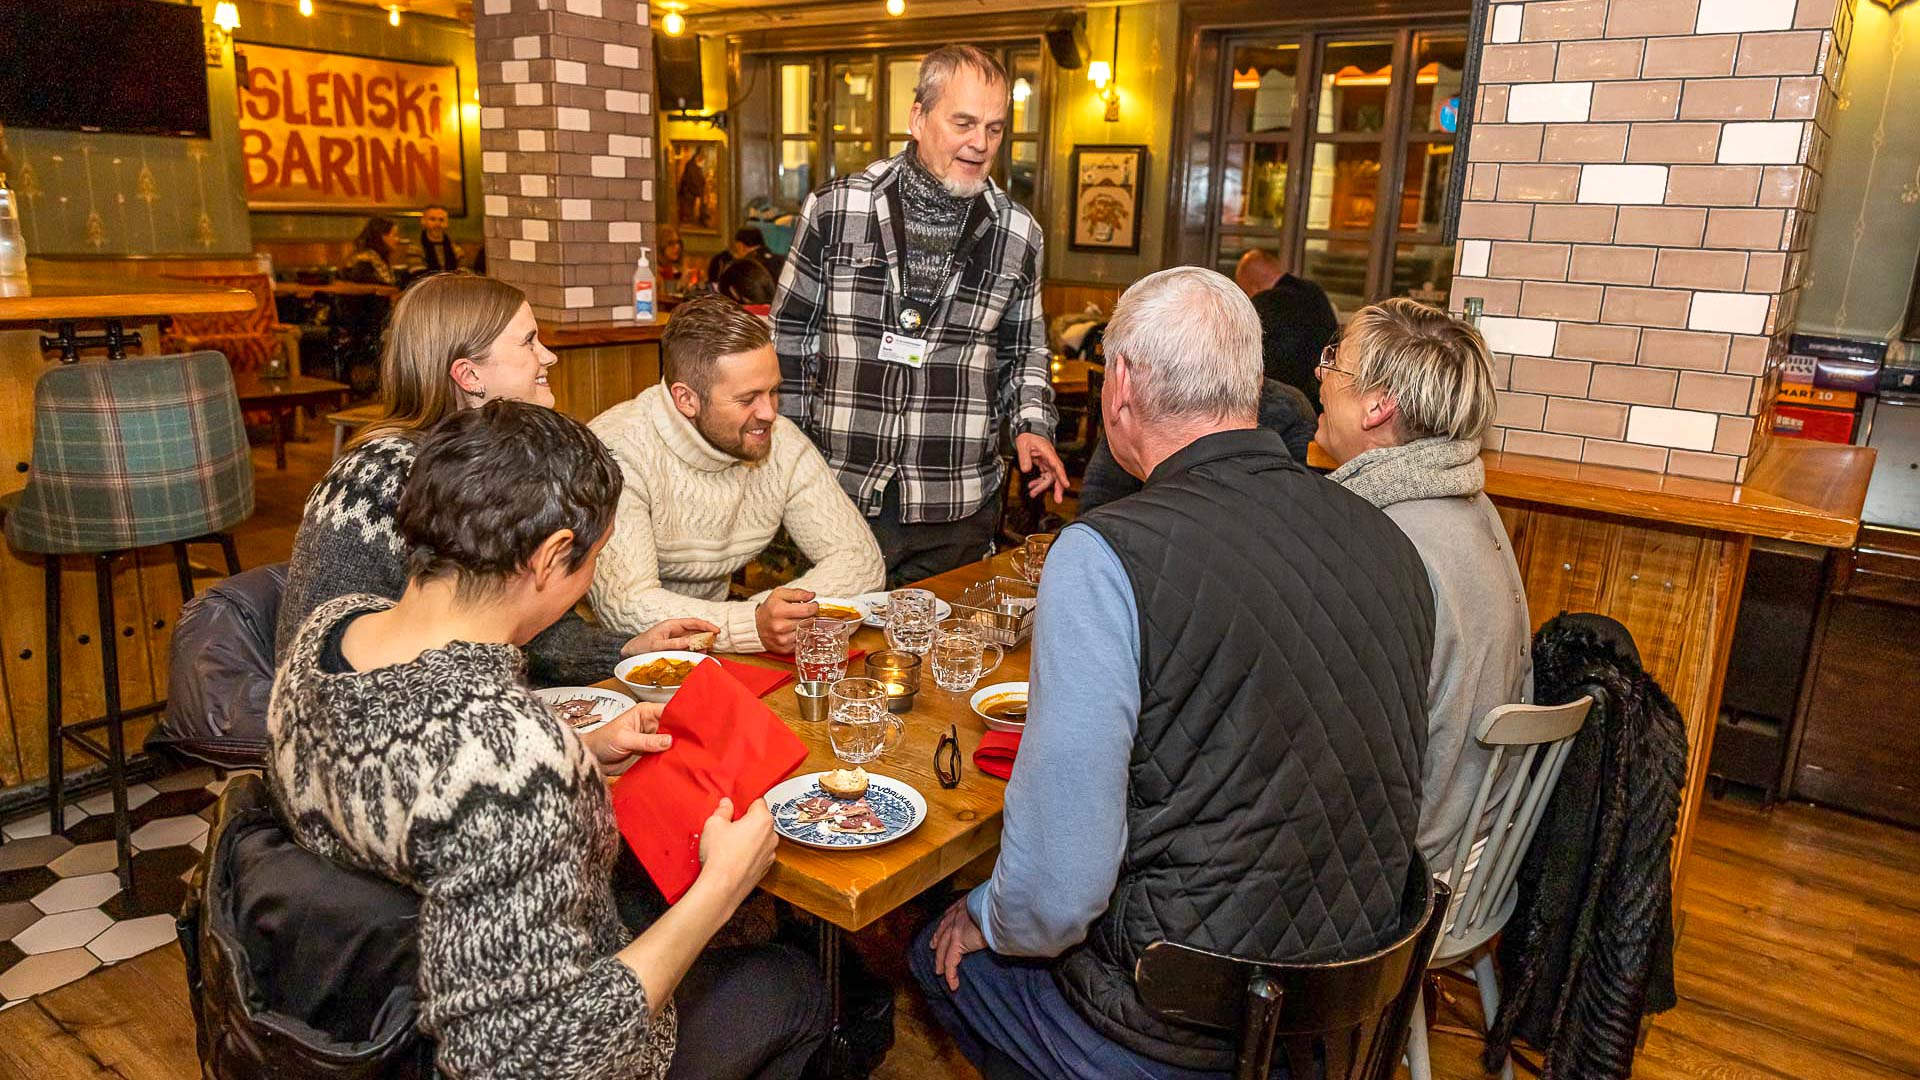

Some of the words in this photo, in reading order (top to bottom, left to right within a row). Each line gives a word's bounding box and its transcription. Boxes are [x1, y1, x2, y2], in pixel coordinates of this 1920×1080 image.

[240, 128, 441, 203] BARINN
[1778, 389, 1816, 399] MART
[1818, 391, 1834, 401] 10
